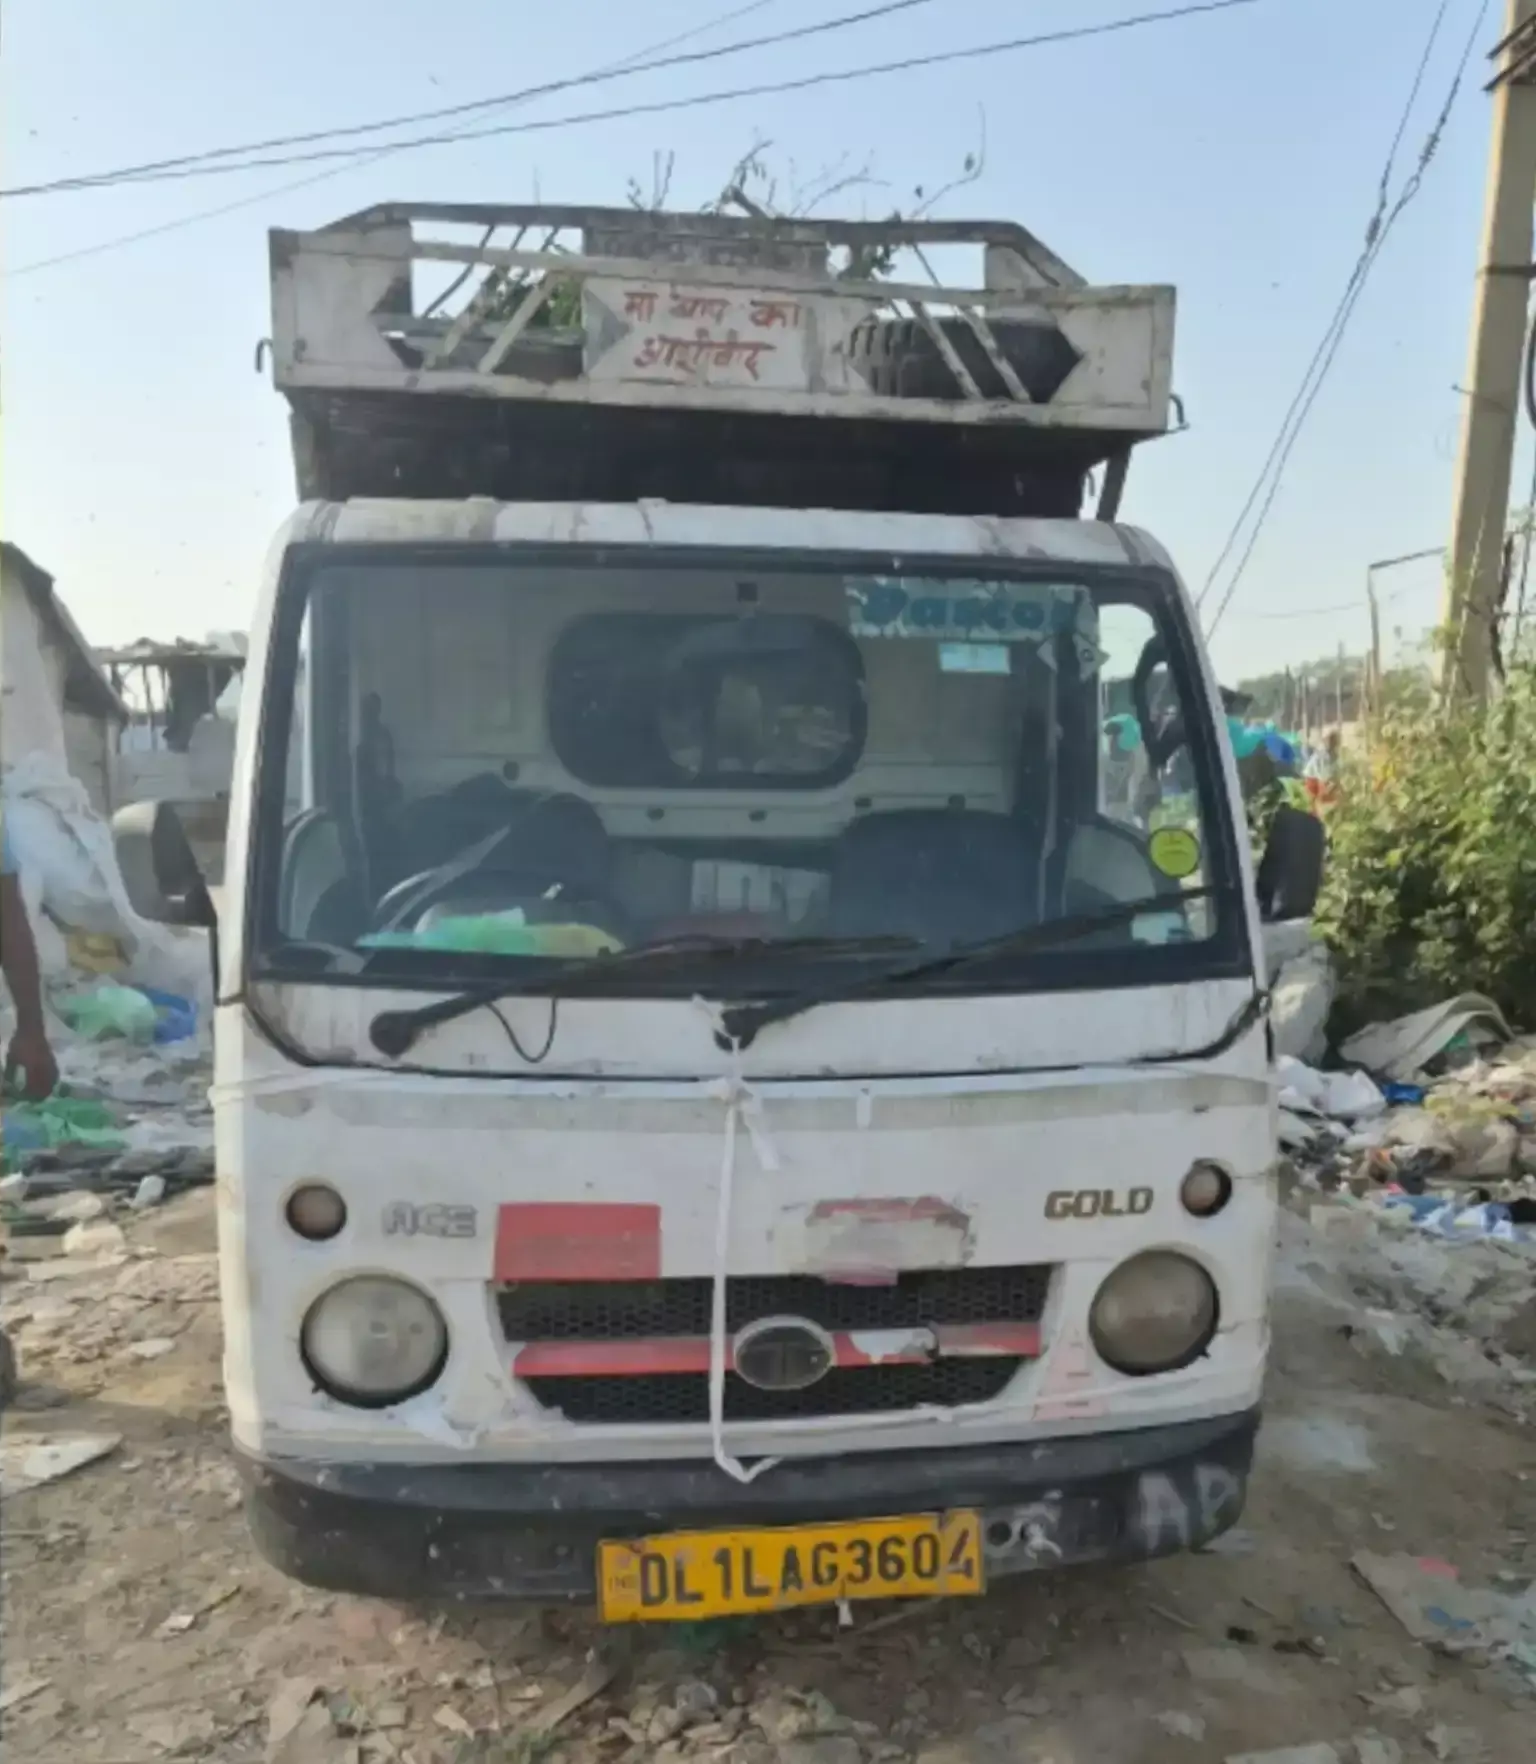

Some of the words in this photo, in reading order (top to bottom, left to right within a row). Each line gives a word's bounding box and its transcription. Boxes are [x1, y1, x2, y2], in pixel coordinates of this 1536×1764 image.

[749, 299, 802, 330] का
[380, 1200, 478, 1239] ACE
[1044, 1187, 1154, 1221] GOLD
[639, 1529, 973, 1608] DL1LAG3604
